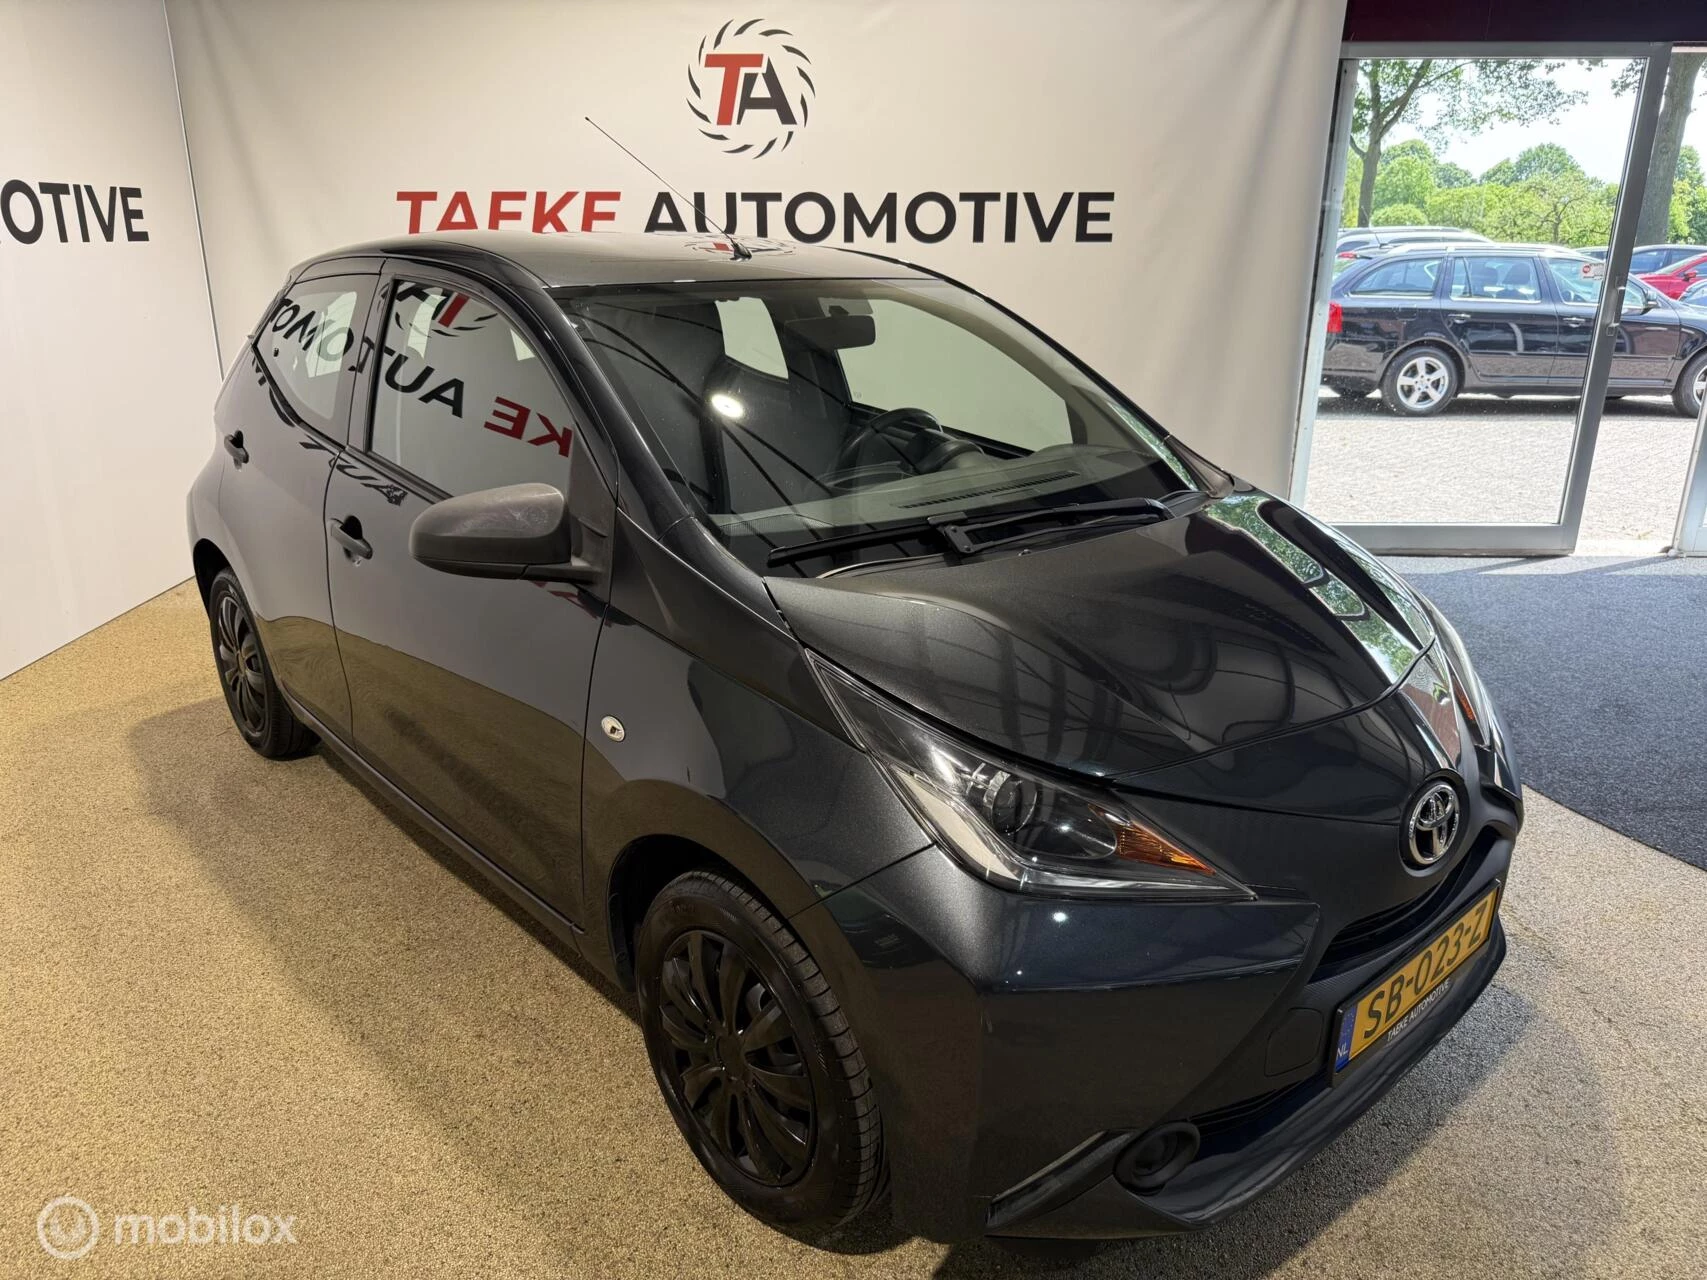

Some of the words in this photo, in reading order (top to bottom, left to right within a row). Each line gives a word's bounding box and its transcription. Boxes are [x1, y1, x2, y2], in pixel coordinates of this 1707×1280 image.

[704, 53, 798, 126] TA
[0, 179, 150, 245] OTIVE
[644, 191, 1115, 243] AUTOMOTIVE
[1363, 900, 1488, 1039] SB-023-Z
[1387, 1016, 1409, 1042] TAEKE
[1409, 977, 1450, 1023] AUTOMOTIVE
[1336, 1045, 1348, 1060] NL
